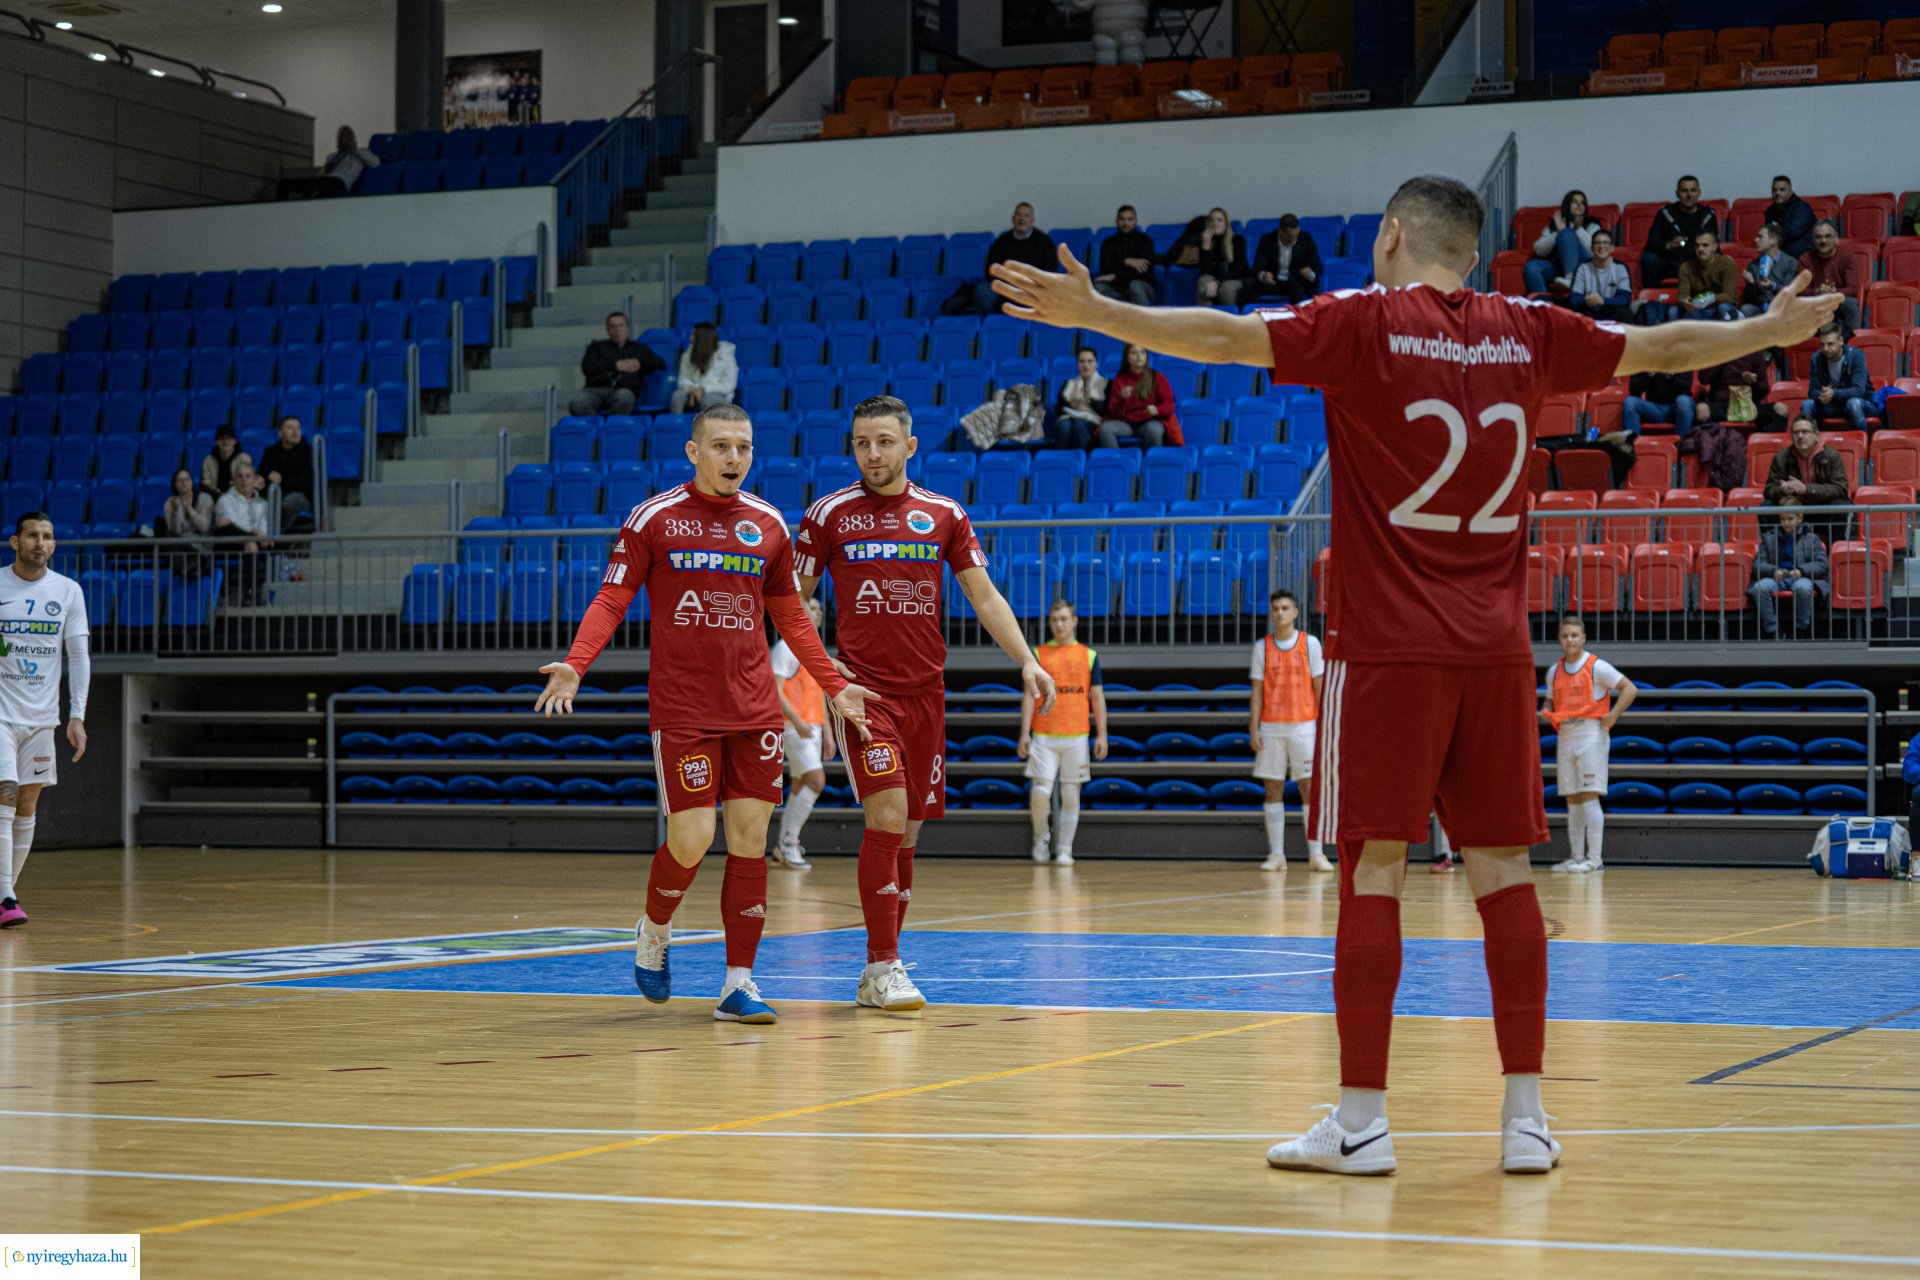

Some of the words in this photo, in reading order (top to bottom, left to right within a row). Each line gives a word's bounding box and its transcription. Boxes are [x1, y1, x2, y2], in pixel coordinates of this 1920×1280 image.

[1756, 66, 1816, 78] MICHELIN
[1471, 82, 1513, 93] CHELIN
[1389, 398, 1528, 533] 22
[665, 518, 703, 537] 383
[838, 513, 875, 533] 383
[25, 599, 36, 616] 7
[855, 601, 936, 616] STUDIO
[674, 612, 754, 631] STUDIO
[867, 747, 890, 761] 99.4
[683, 759, 708, 775] 99.4
[874, 762, 888, 772] FM
[930, 754, 942, 785] 8
[693, 776, 707, 787] FM
